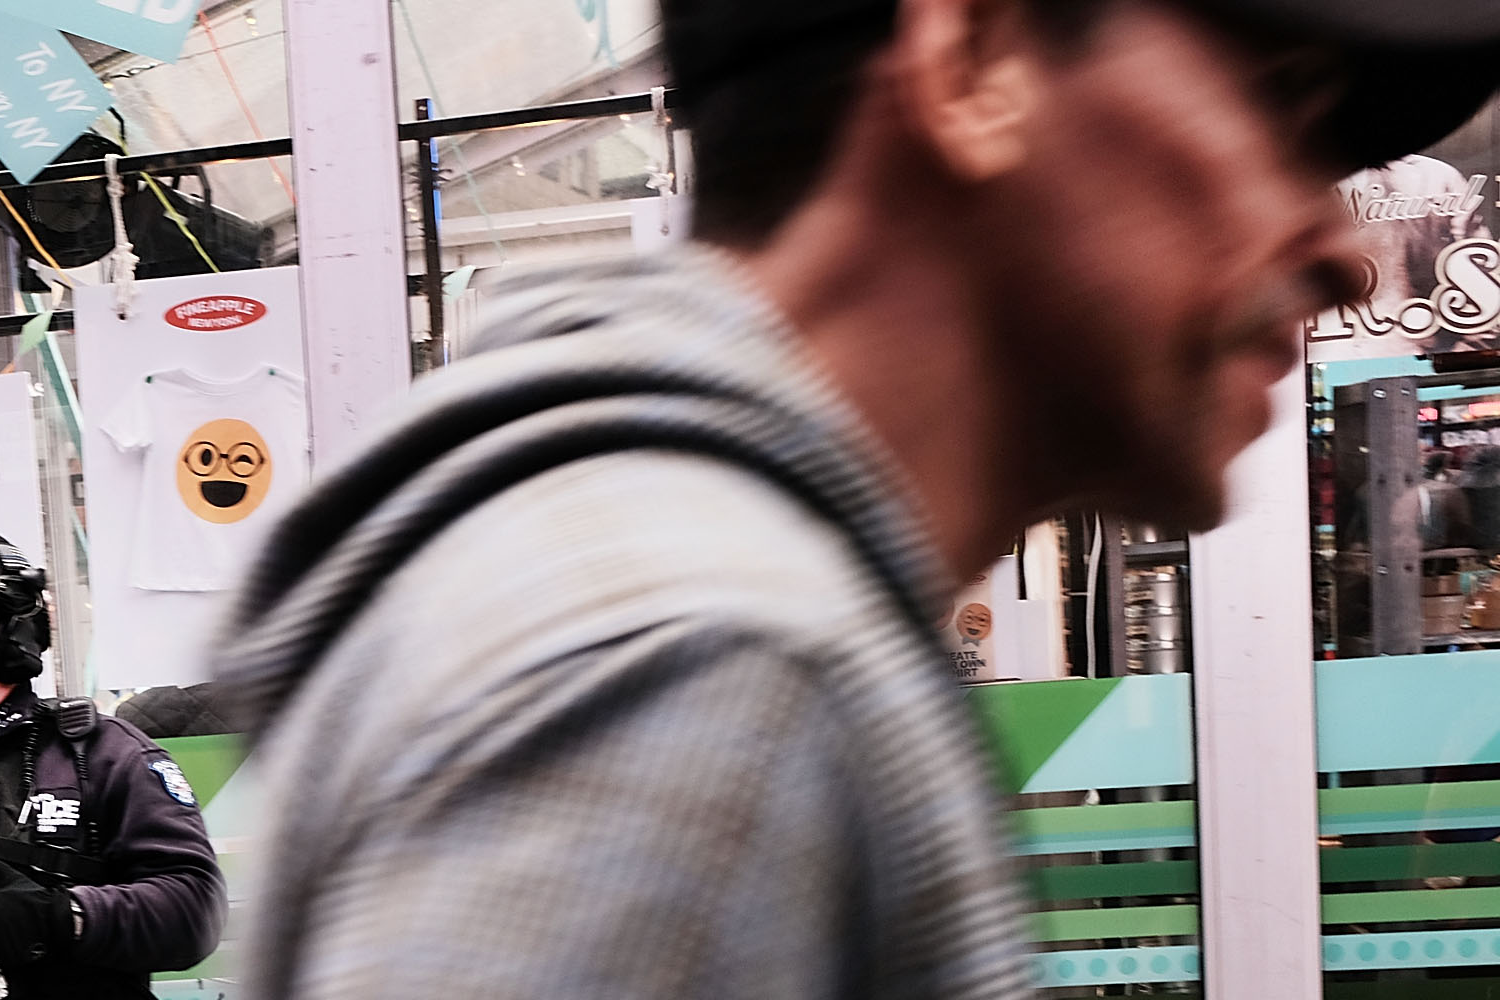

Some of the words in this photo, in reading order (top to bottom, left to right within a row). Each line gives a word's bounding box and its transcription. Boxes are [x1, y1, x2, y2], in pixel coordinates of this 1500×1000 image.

[16, 42, 56, 77] To
[39, 78, 98, 113] NY
[4, 116, 61, 149] NY
[1338, 173, 1486, 228] Natural
[174, 299, 257, 320] PINEAPPLE
